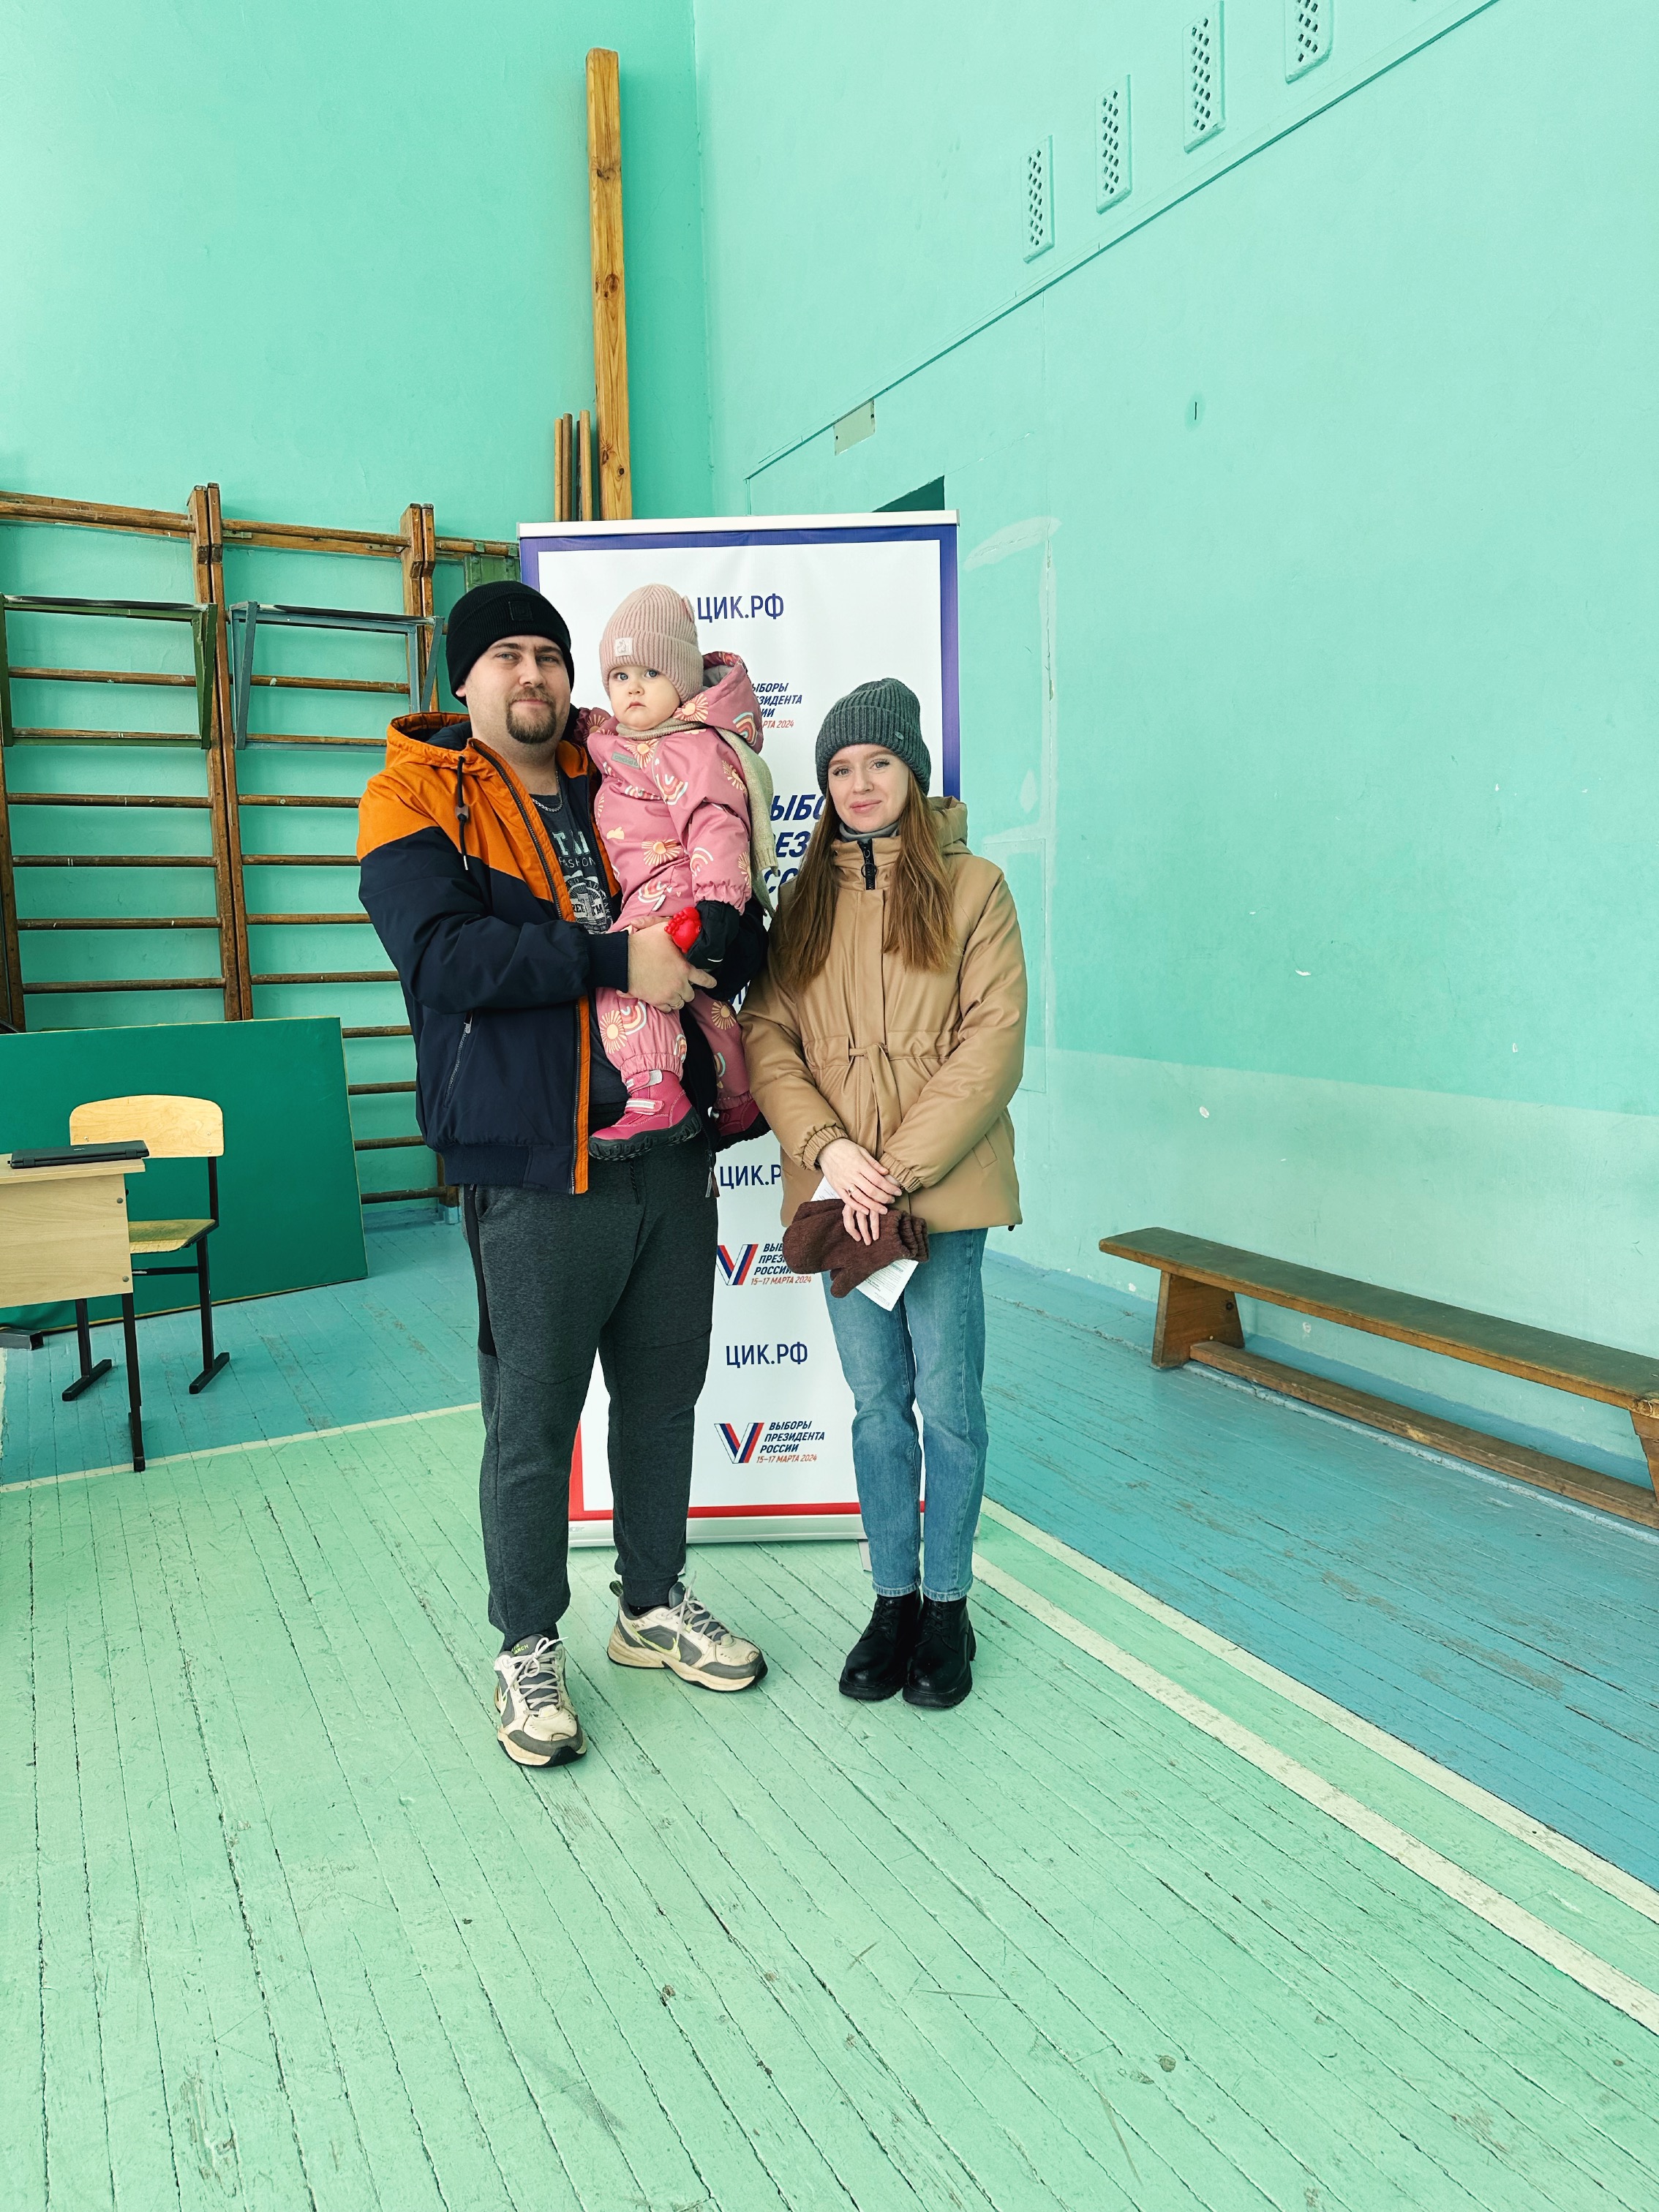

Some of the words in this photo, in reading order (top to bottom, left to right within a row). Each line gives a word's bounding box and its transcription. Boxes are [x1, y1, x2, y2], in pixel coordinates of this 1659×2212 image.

[697, 593, 784, 622] ЦИК.РФ
[752, 682, 789, 693] ЫБОРЫ
[756, 694, 802, 706] ЗИДЕНТА
[762, 721, 775, 729] РТА
[777, 720, 794, 729] 2024
[720, 1165, 781, 1189] ЦИК.Р
[770, 1276, 794, 1284] МАРТА
[795, 1275, 812, 1284] 2024
[726, 1342, 808, 1368] ЦИК.РФ
[769, 1421, 813, 1431] ВЫБОРЫ
[764, 1432, 825, 1442] ПРЕЗИДЕНТА
[759, 1443, 800, 1453] РОССИИ
[776, 1454, 800, 1463] МАРТА
[800, 1453, 817, 1462] 2024
